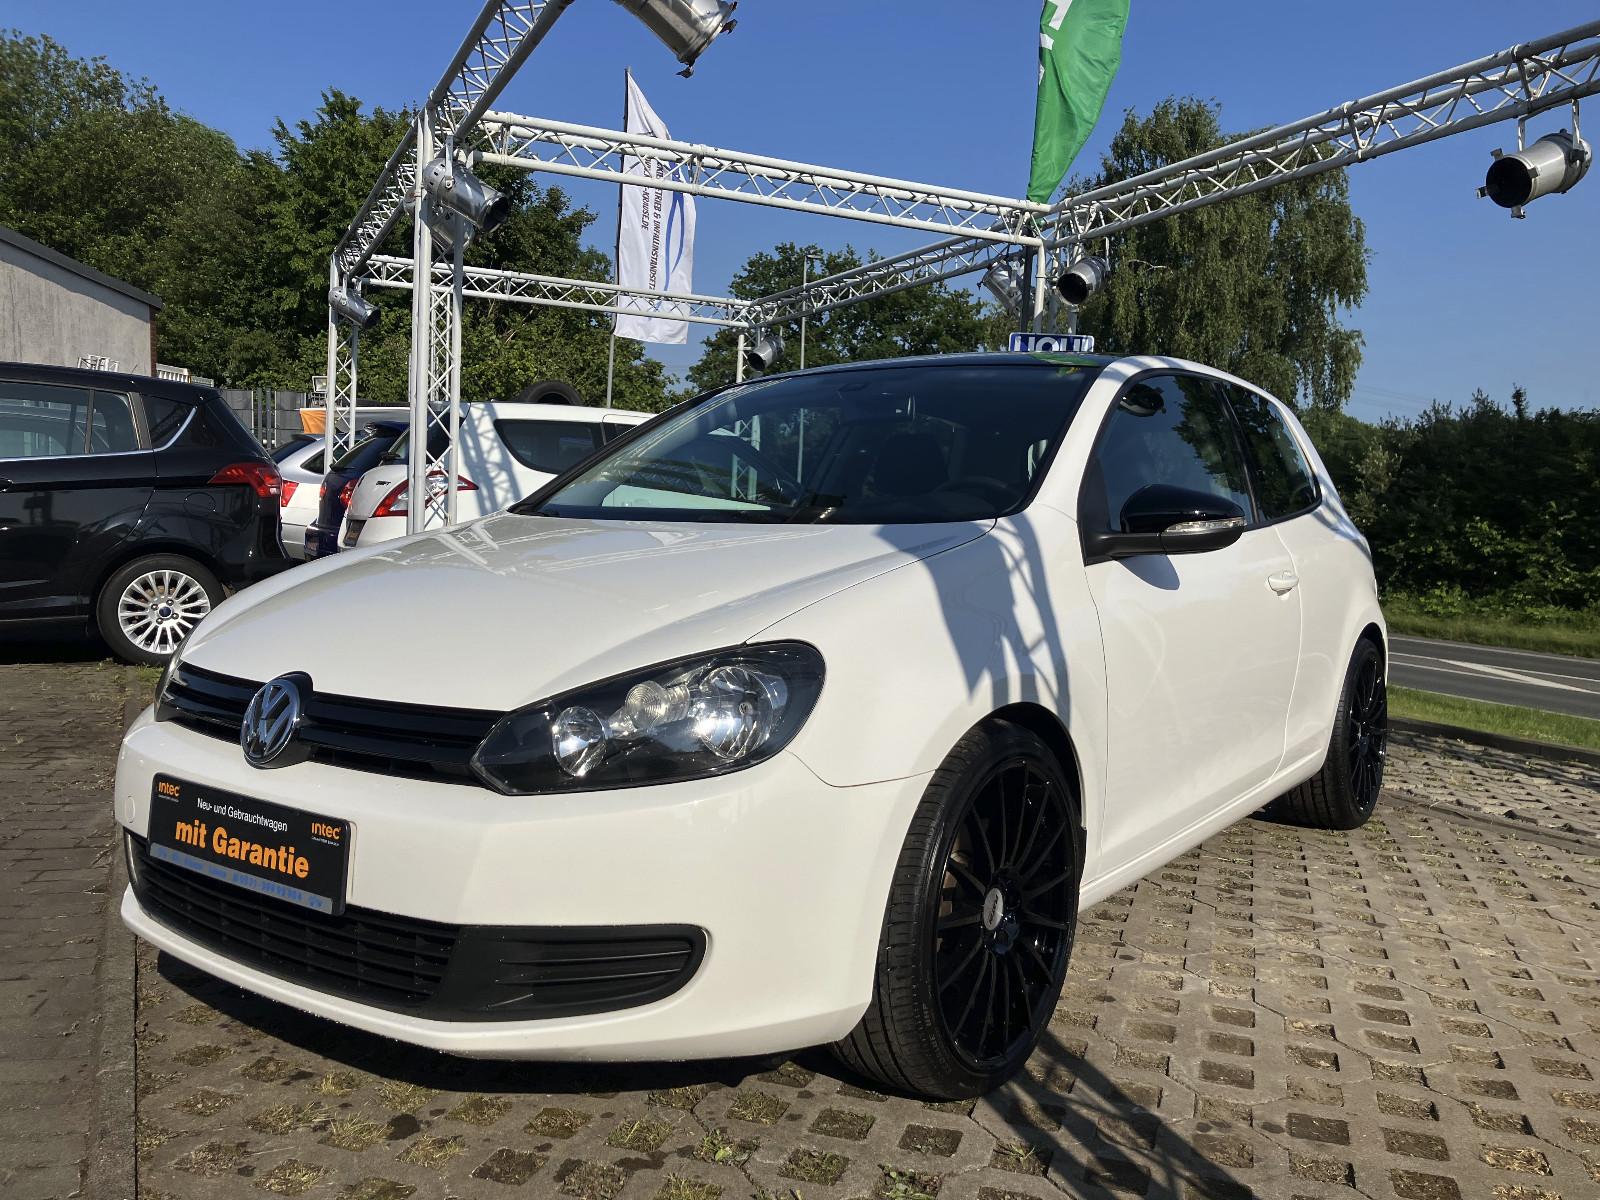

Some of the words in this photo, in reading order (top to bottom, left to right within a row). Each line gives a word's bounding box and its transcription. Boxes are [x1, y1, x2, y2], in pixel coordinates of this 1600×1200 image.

[653, 212, 661, 220] &
[158, 782, 180, 797] intec
[197, 797, 213, 811] Neu-
[213, 804, 227, 816] und
[227, 806, 288, 832] Gebrauchtwagen
[311, 822, 340, 840] intec
[175, 819, 207, 849] mit
[212, 826, 309, 879] Garantie
